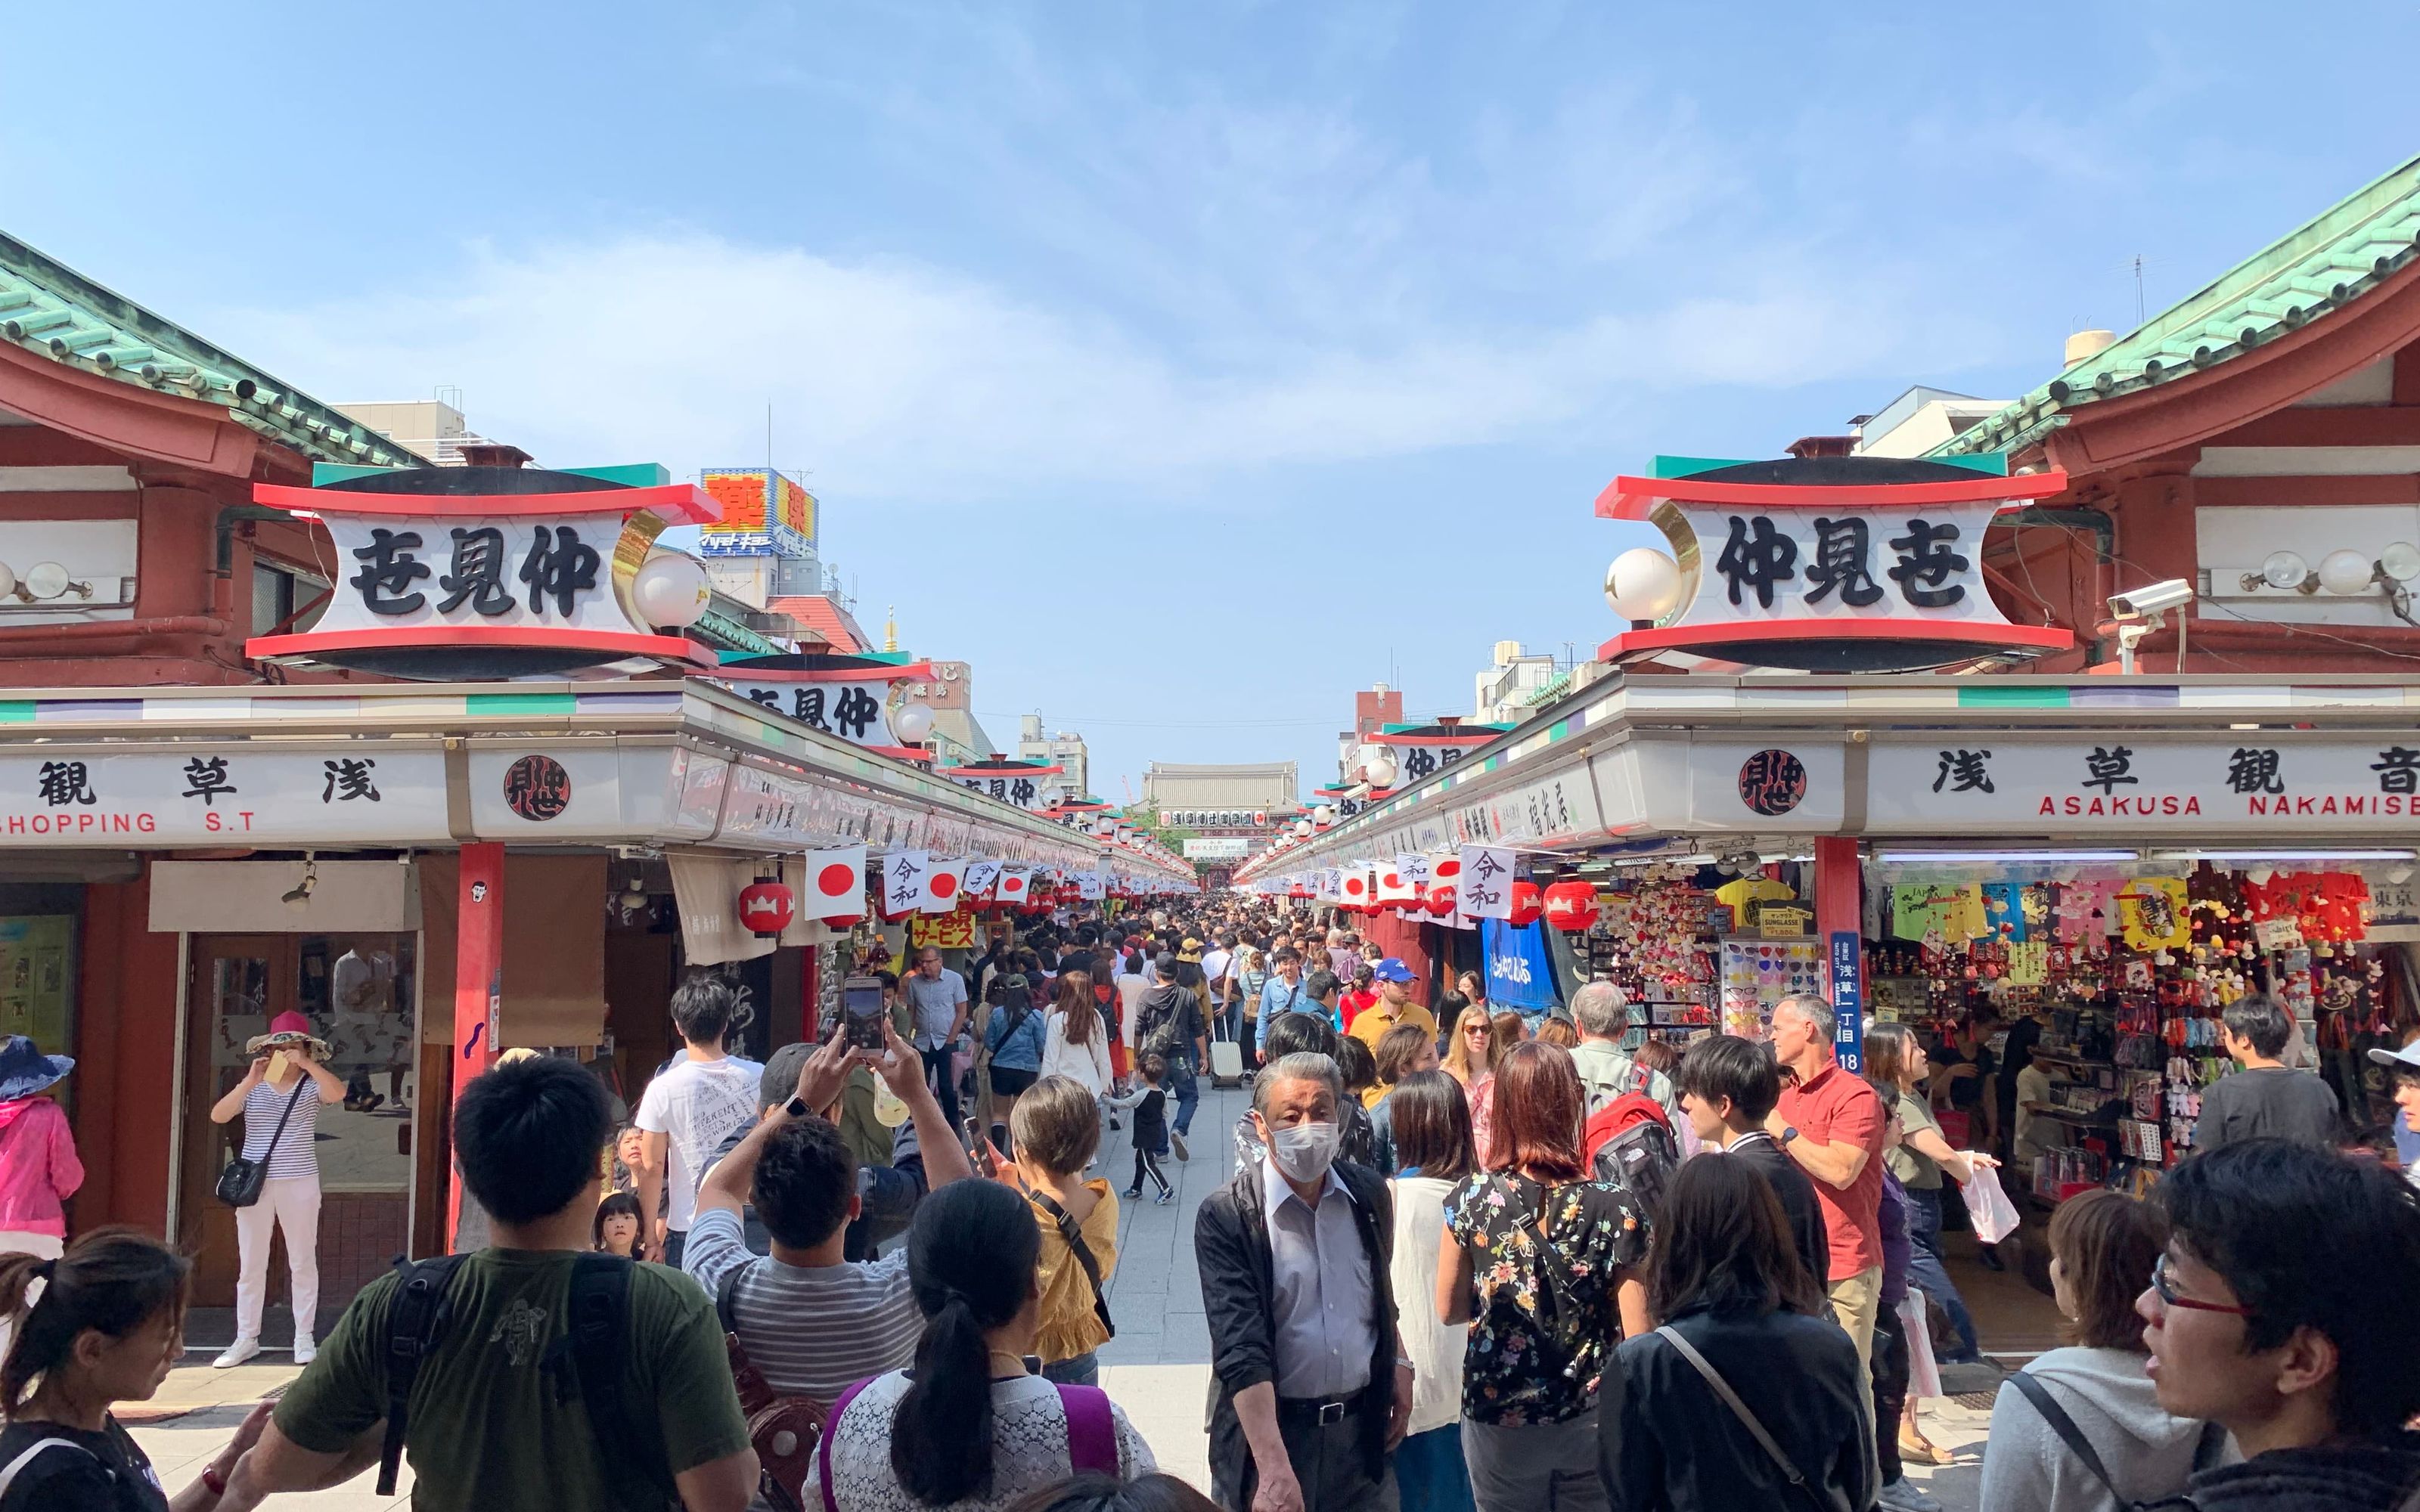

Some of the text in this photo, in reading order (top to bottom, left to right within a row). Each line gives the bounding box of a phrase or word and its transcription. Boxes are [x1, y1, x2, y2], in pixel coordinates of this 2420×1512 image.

[699, 532, 771, 550] マツモトキヨシ
[1717, 515, 1969, 609] 仲見世
[2039, 796, 2202, 816] ASAKUSA
[0, 812, 256, 834] HOPPING S.T
[891, 857, 921, 906] 令和
[1466, 850, 1506, 911] 令和
[2374, 890, 2414, 908] 東京
[914, 928, 974, 946] サービス
[1840, 965, 1854, 1043] 浅草一丁目
[1840, 1054, 1857, 1070] 18
